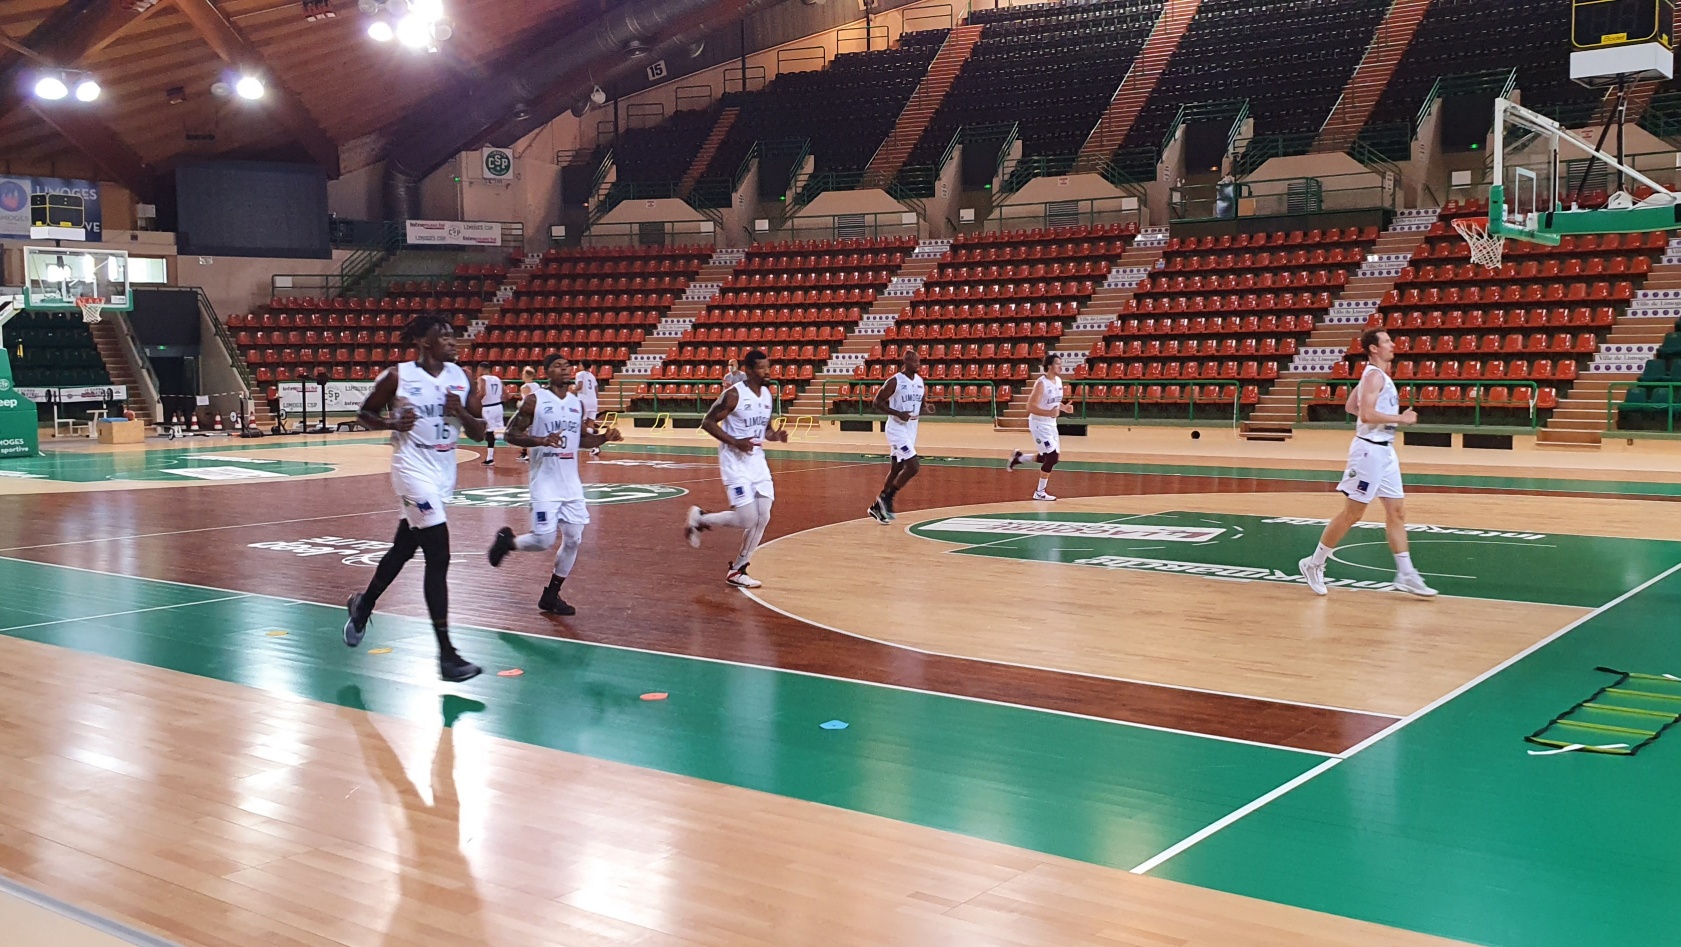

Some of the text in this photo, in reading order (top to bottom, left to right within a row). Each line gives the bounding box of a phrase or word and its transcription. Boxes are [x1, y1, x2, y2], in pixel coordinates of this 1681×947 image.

[649, 64, 662, 77] 15
[488, 155, 508, 169] CSP
[491, 383, 498, 396] 17
[588, 379, 592, 390] 3
[433, 423, 450, 439] 16
